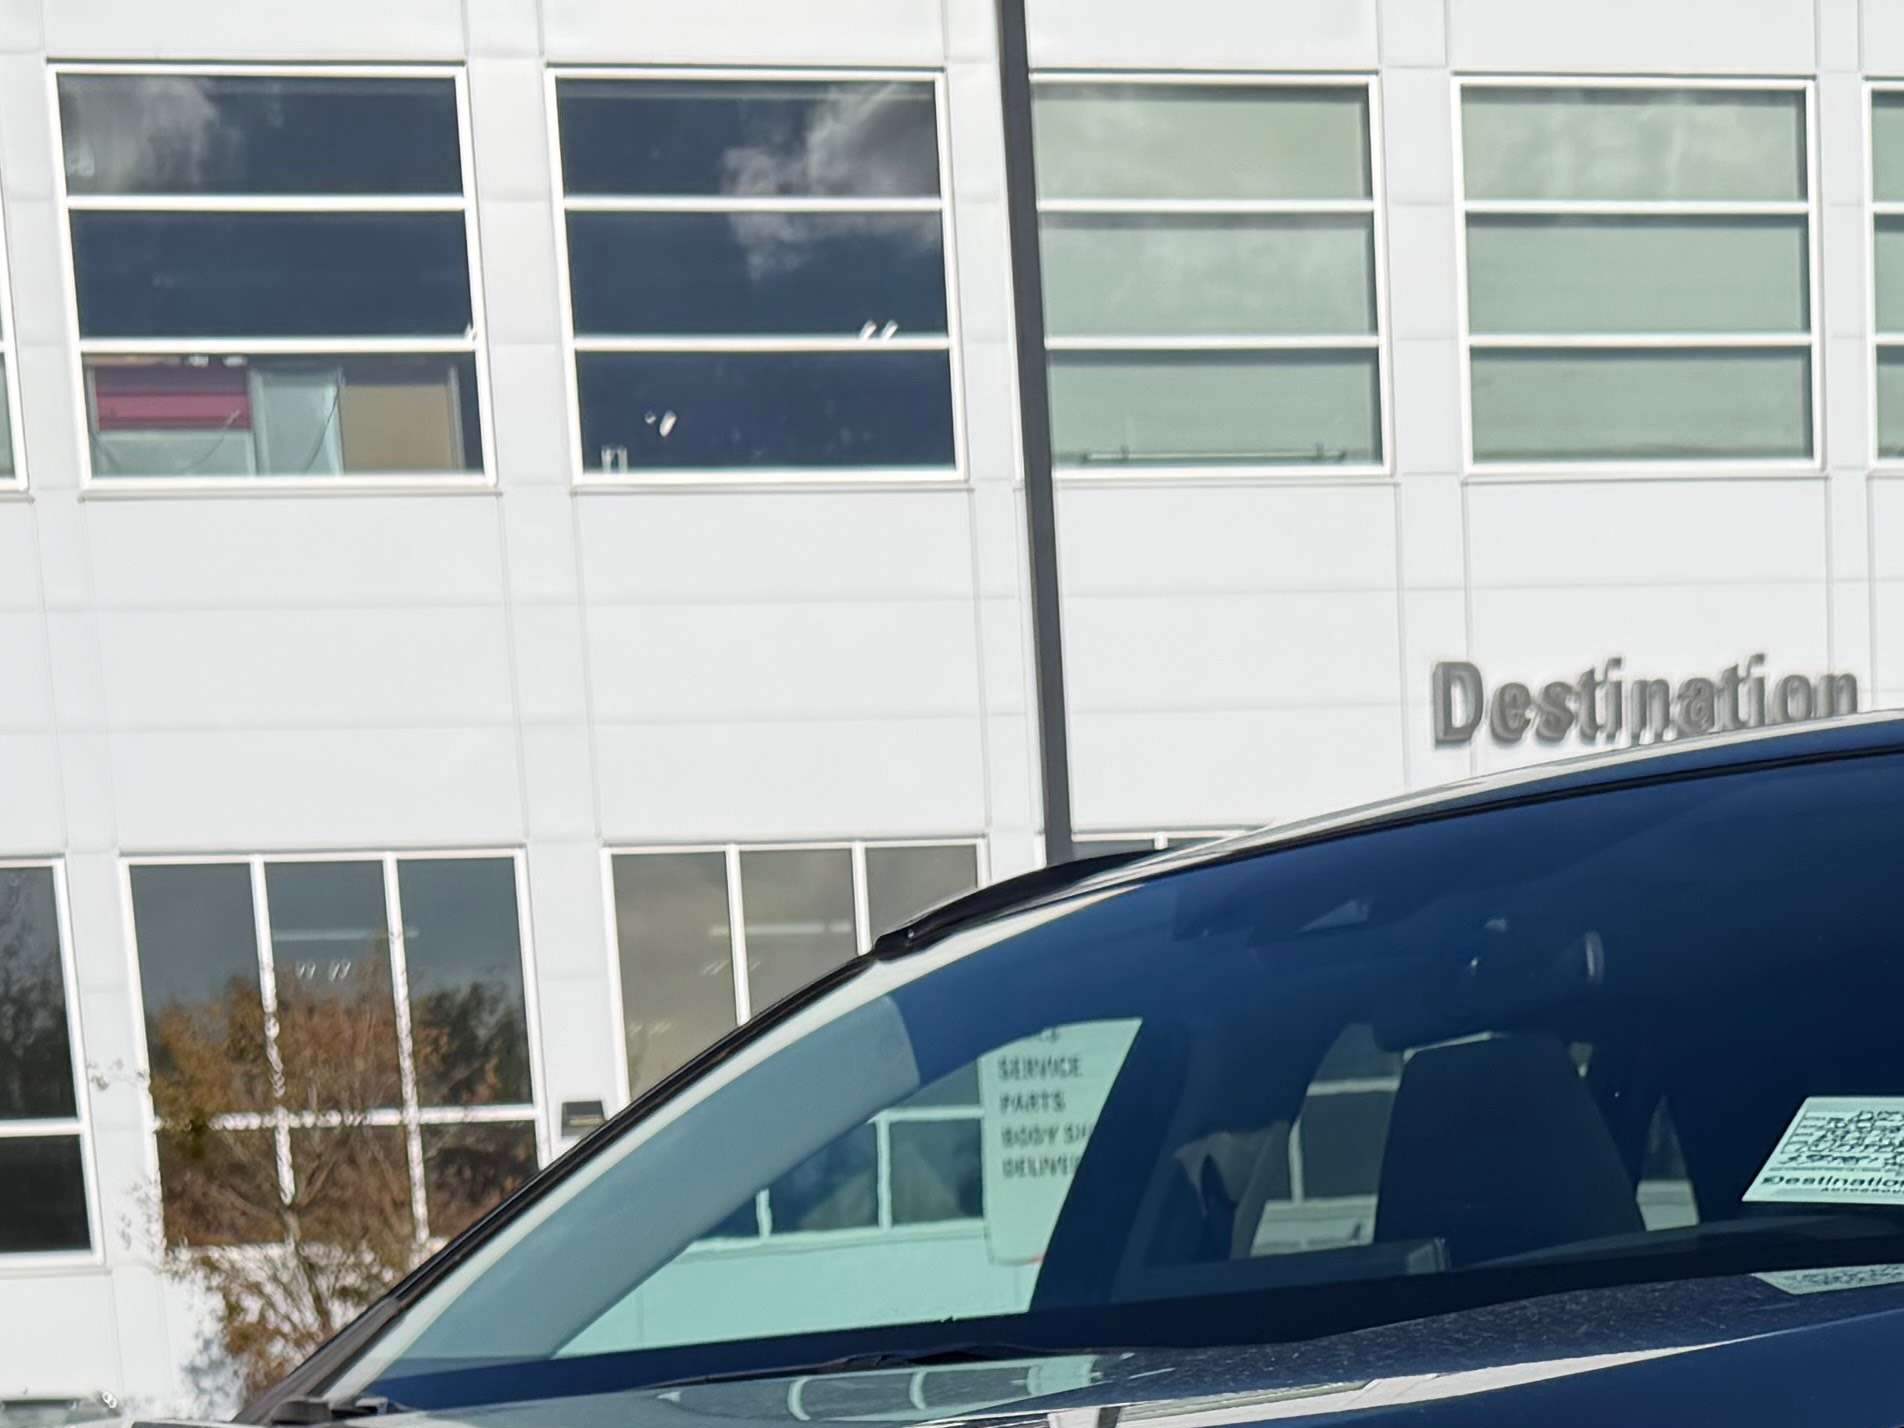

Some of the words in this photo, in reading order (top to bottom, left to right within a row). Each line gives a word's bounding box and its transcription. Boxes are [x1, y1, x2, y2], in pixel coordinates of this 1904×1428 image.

[1432, 653, 1859, 750] Destination
[998, 1056, 1083, 1080] SERVICE
[1000, 1090, 1067, 1115] PARTS
[1001, 1124, 1059, 1147] BODY
[1063, 1121, 1094, 1144] SH
